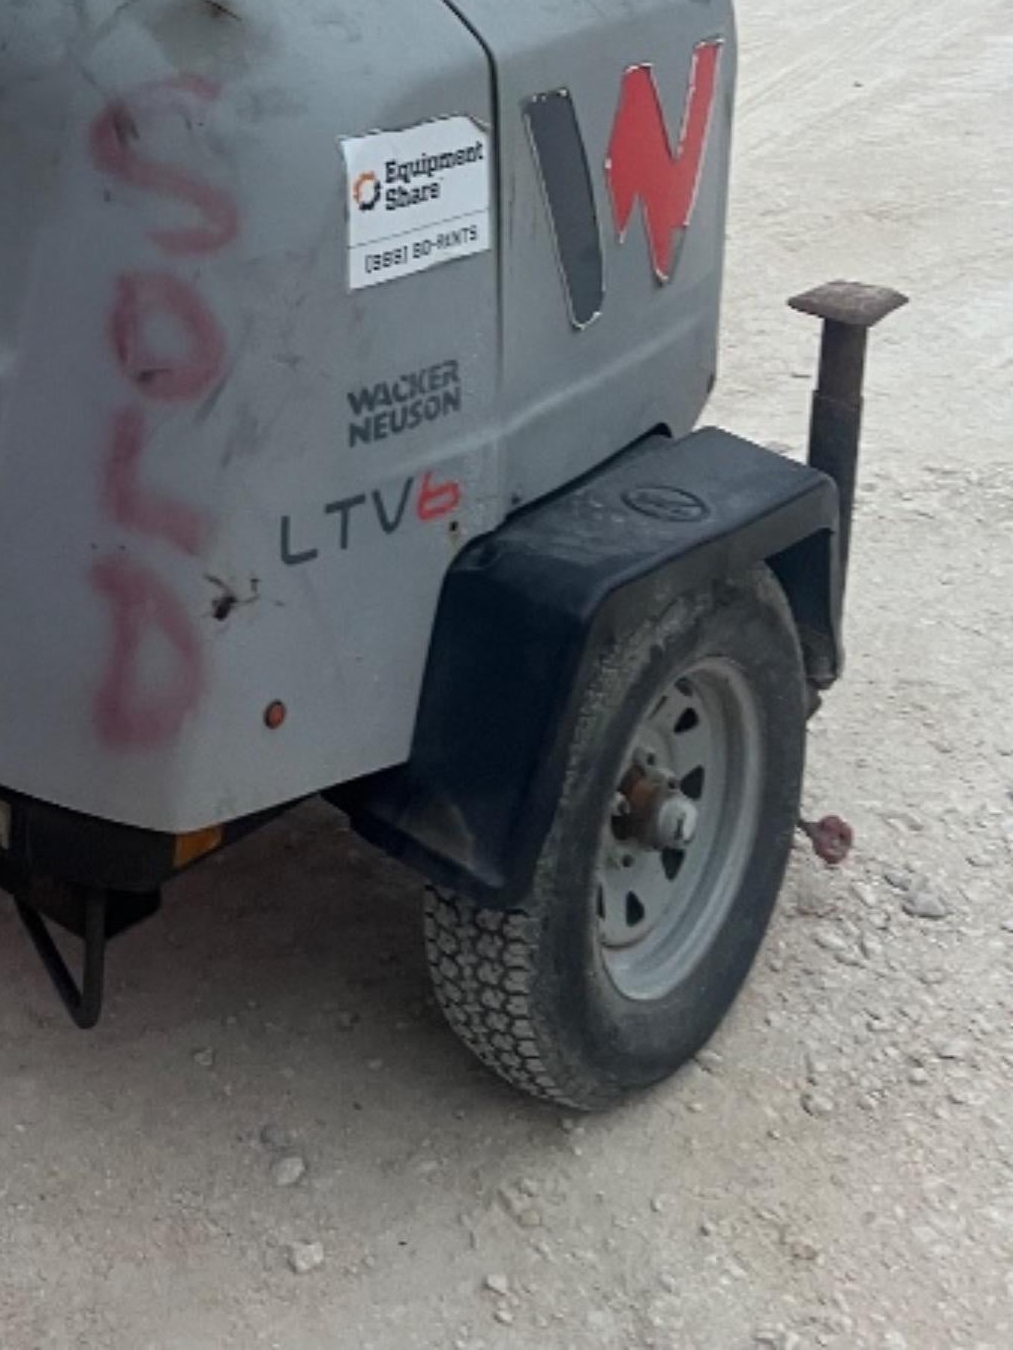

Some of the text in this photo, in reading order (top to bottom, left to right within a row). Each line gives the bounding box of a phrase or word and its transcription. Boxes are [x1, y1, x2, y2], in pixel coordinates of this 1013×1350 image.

[384, 140, 484, 184] Equipment
[384, 182, 441, 211] Share
[346, 359, 460, 416] WACKER
[348, 386, 462, 448] NEUSON
